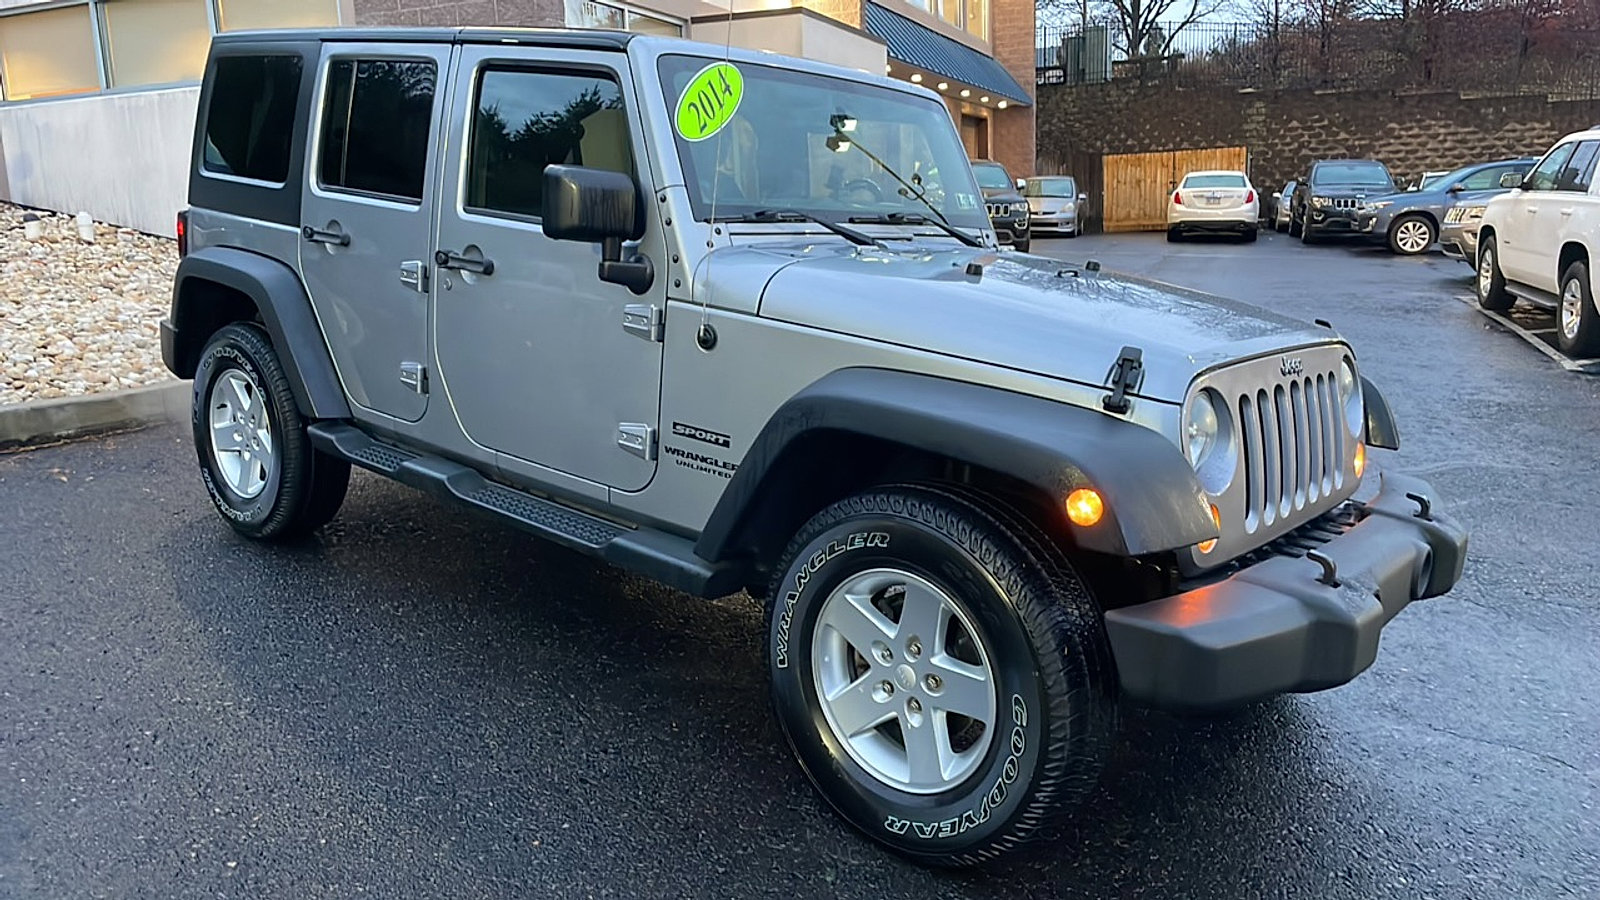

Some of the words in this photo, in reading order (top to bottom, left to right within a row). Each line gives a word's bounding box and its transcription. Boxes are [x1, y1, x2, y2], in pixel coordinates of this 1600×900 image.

[687, 67, 733, 133] 2014
[1280, 356, 1303, 377] Jeep
[673, 424, 730, 446] SPORT
[676, 459, 732, 479] UNLIMITED
[777, 532, 890, 668] WRANGLER
[884, 693, 1027, 838] GOODYEAR
